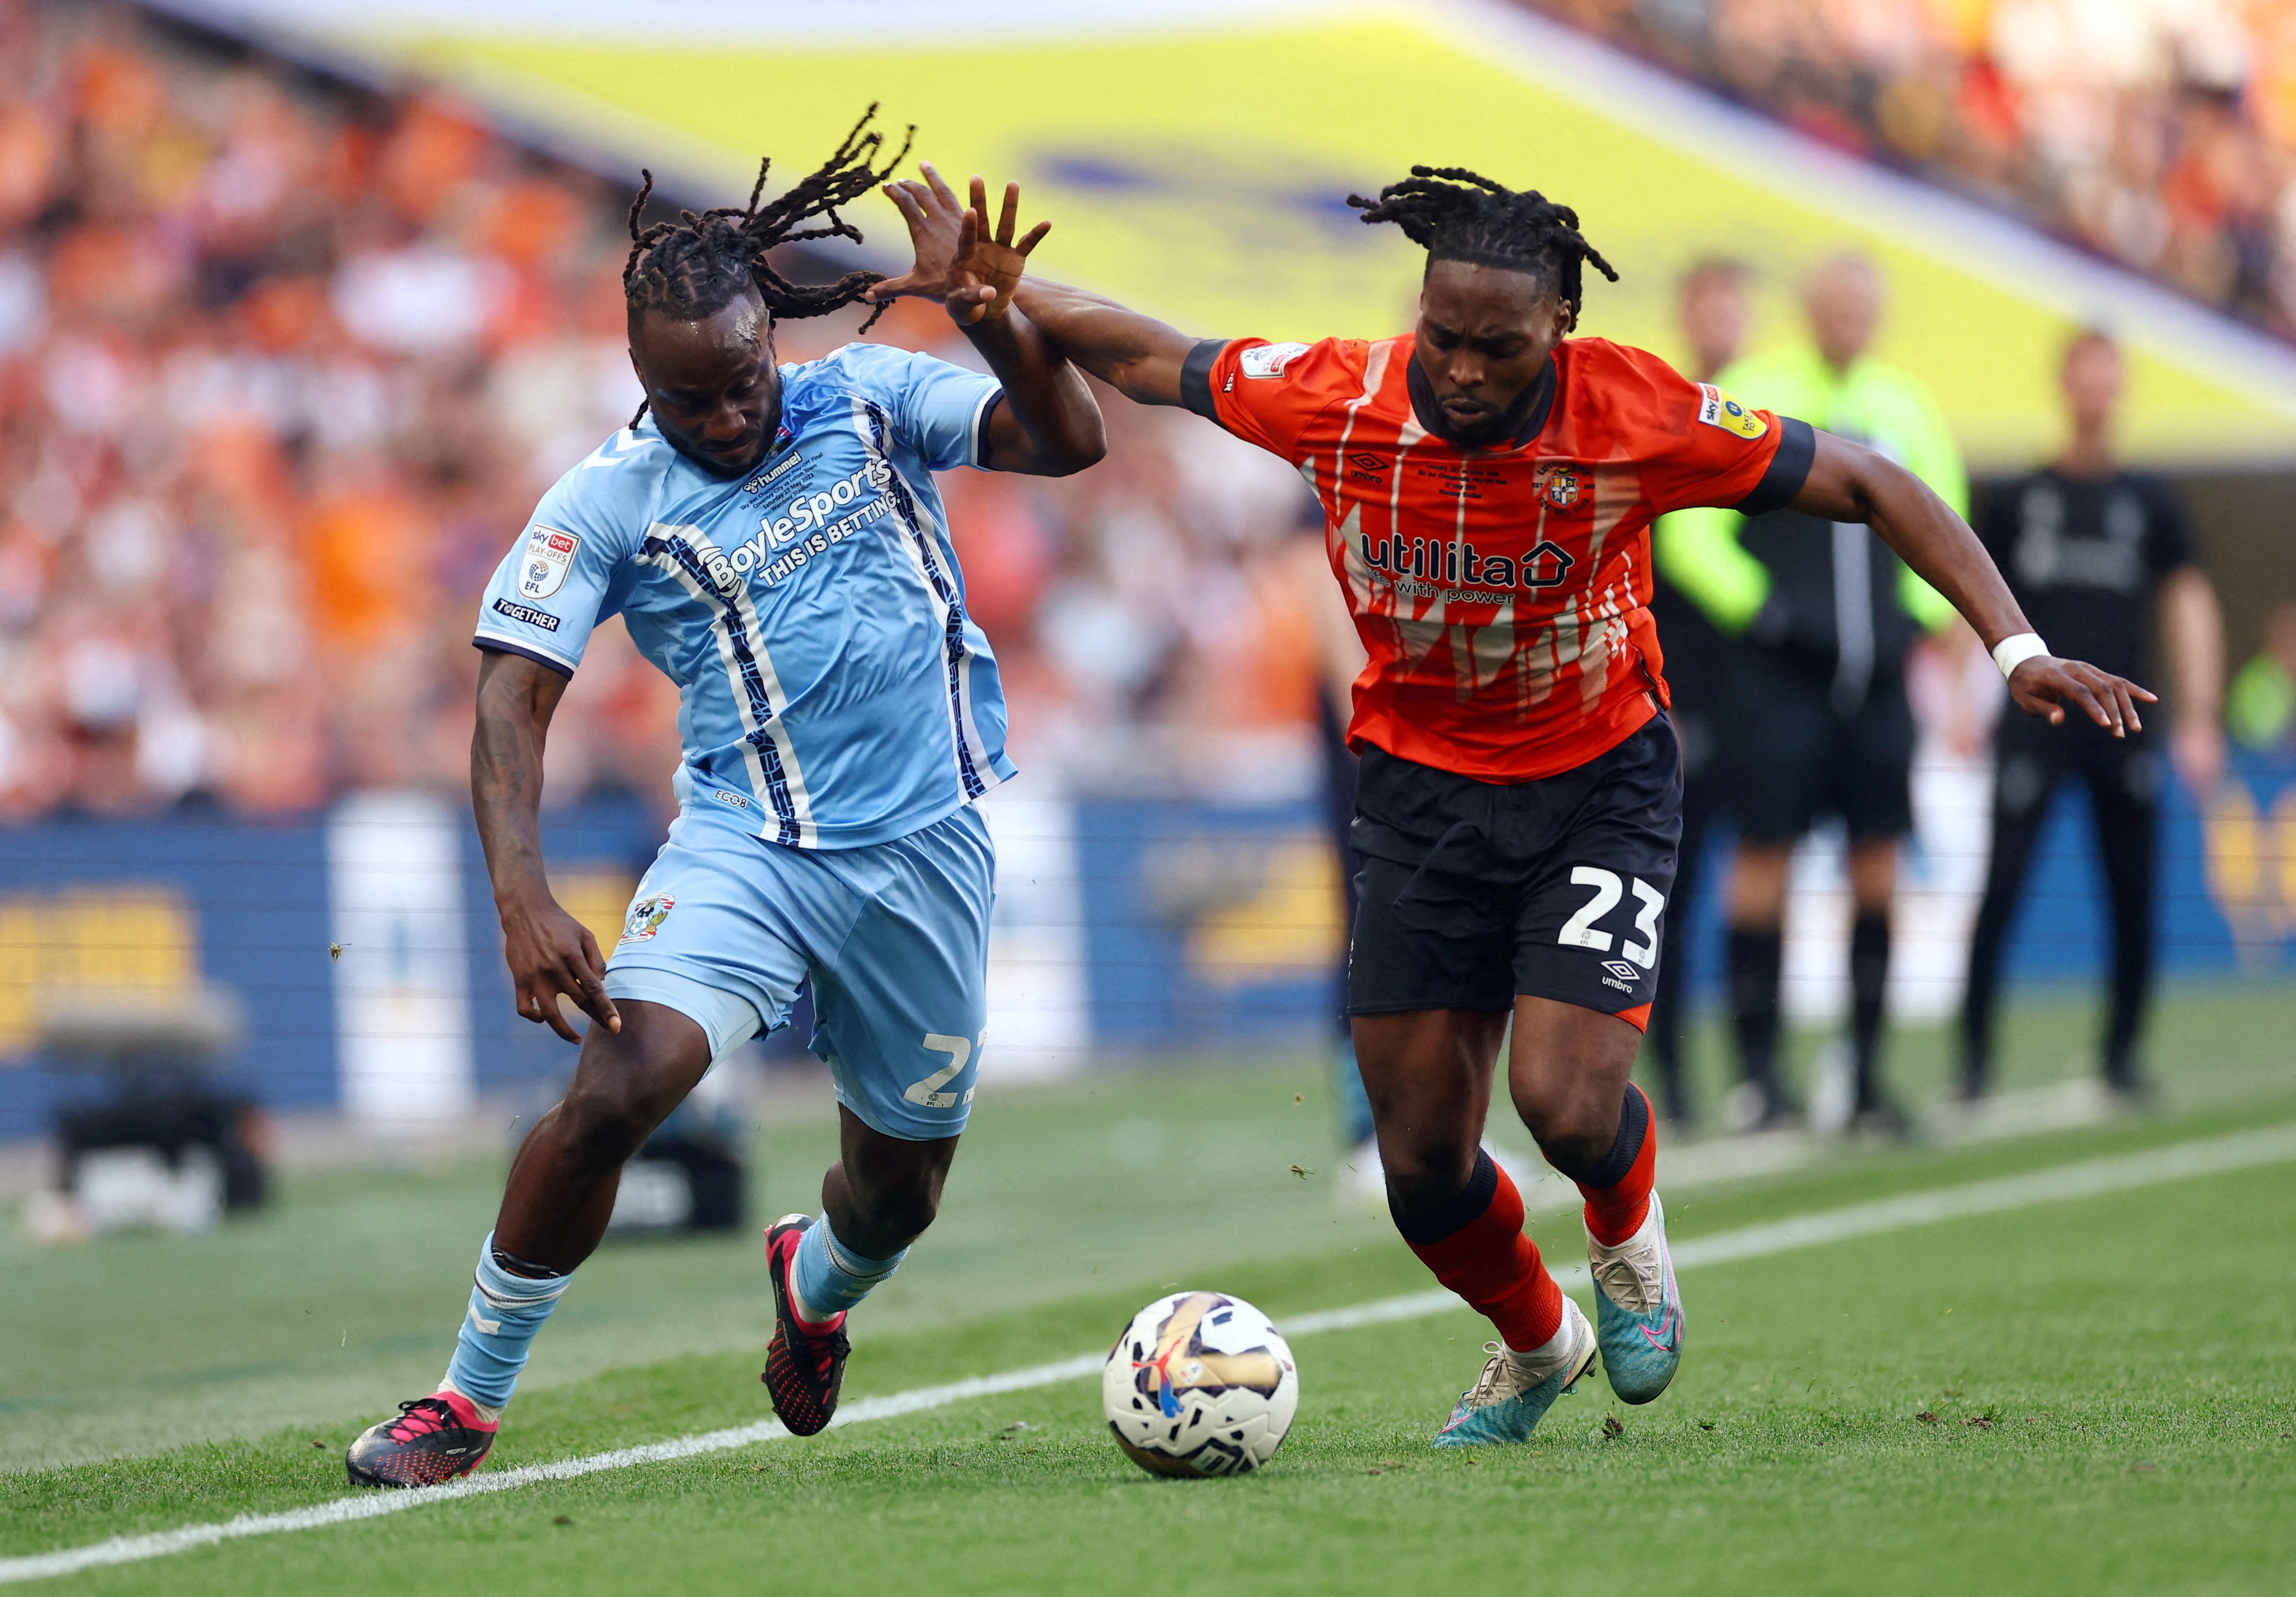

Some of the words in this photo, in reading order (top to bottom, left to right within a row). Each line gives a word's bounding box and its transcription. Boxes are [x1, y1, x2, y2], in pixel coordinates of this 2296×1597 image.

[1706, 401, 1718, 420] sky
[1749, 422, 1755, 431] TO
[757, 451, 802, 487] hummel
[758, 473, 791, 498] Championship
[791, 459, 811, 474] Play-Off
[811, 452, 823, 463] Final
[1350, 469, 1382, 483] umbro
[753, 491, 774, 509] Coventry
[774, 485, 784, 494] City
[790, 472, 804, 482] Luton
[804, 464, 818, 473] Town
[763, 493, 784, 510] Saturday
[791, 481, 801, 490] May
[802, 473, 814, 483] 2023
[771, 495, 793, 511] Wembley
[793, 481, 813, 496] Stadium
[533, 530, 549, 544] sky
[551, 535, 571, 550] bet
[698, 458, 892, 598] BoyleSports
[758, 544, 807, 588] THIS
[804, 531, 828, 557] IS
[826, 490, 901, 544] BETTING.
[529, 544, 567, 562] PLAY-OFFS
[1361, 533, 1516, 588] utilita
[525, 581, 539, 593] EFL
[1394, 580, 1439, 598] with
[1446, 589, 1514, 604] power
[497, 600, 558, 630] TOGETHER
[1557, 866, 1665, 970] 23
[1602, 976, 1633, 994] umbro
